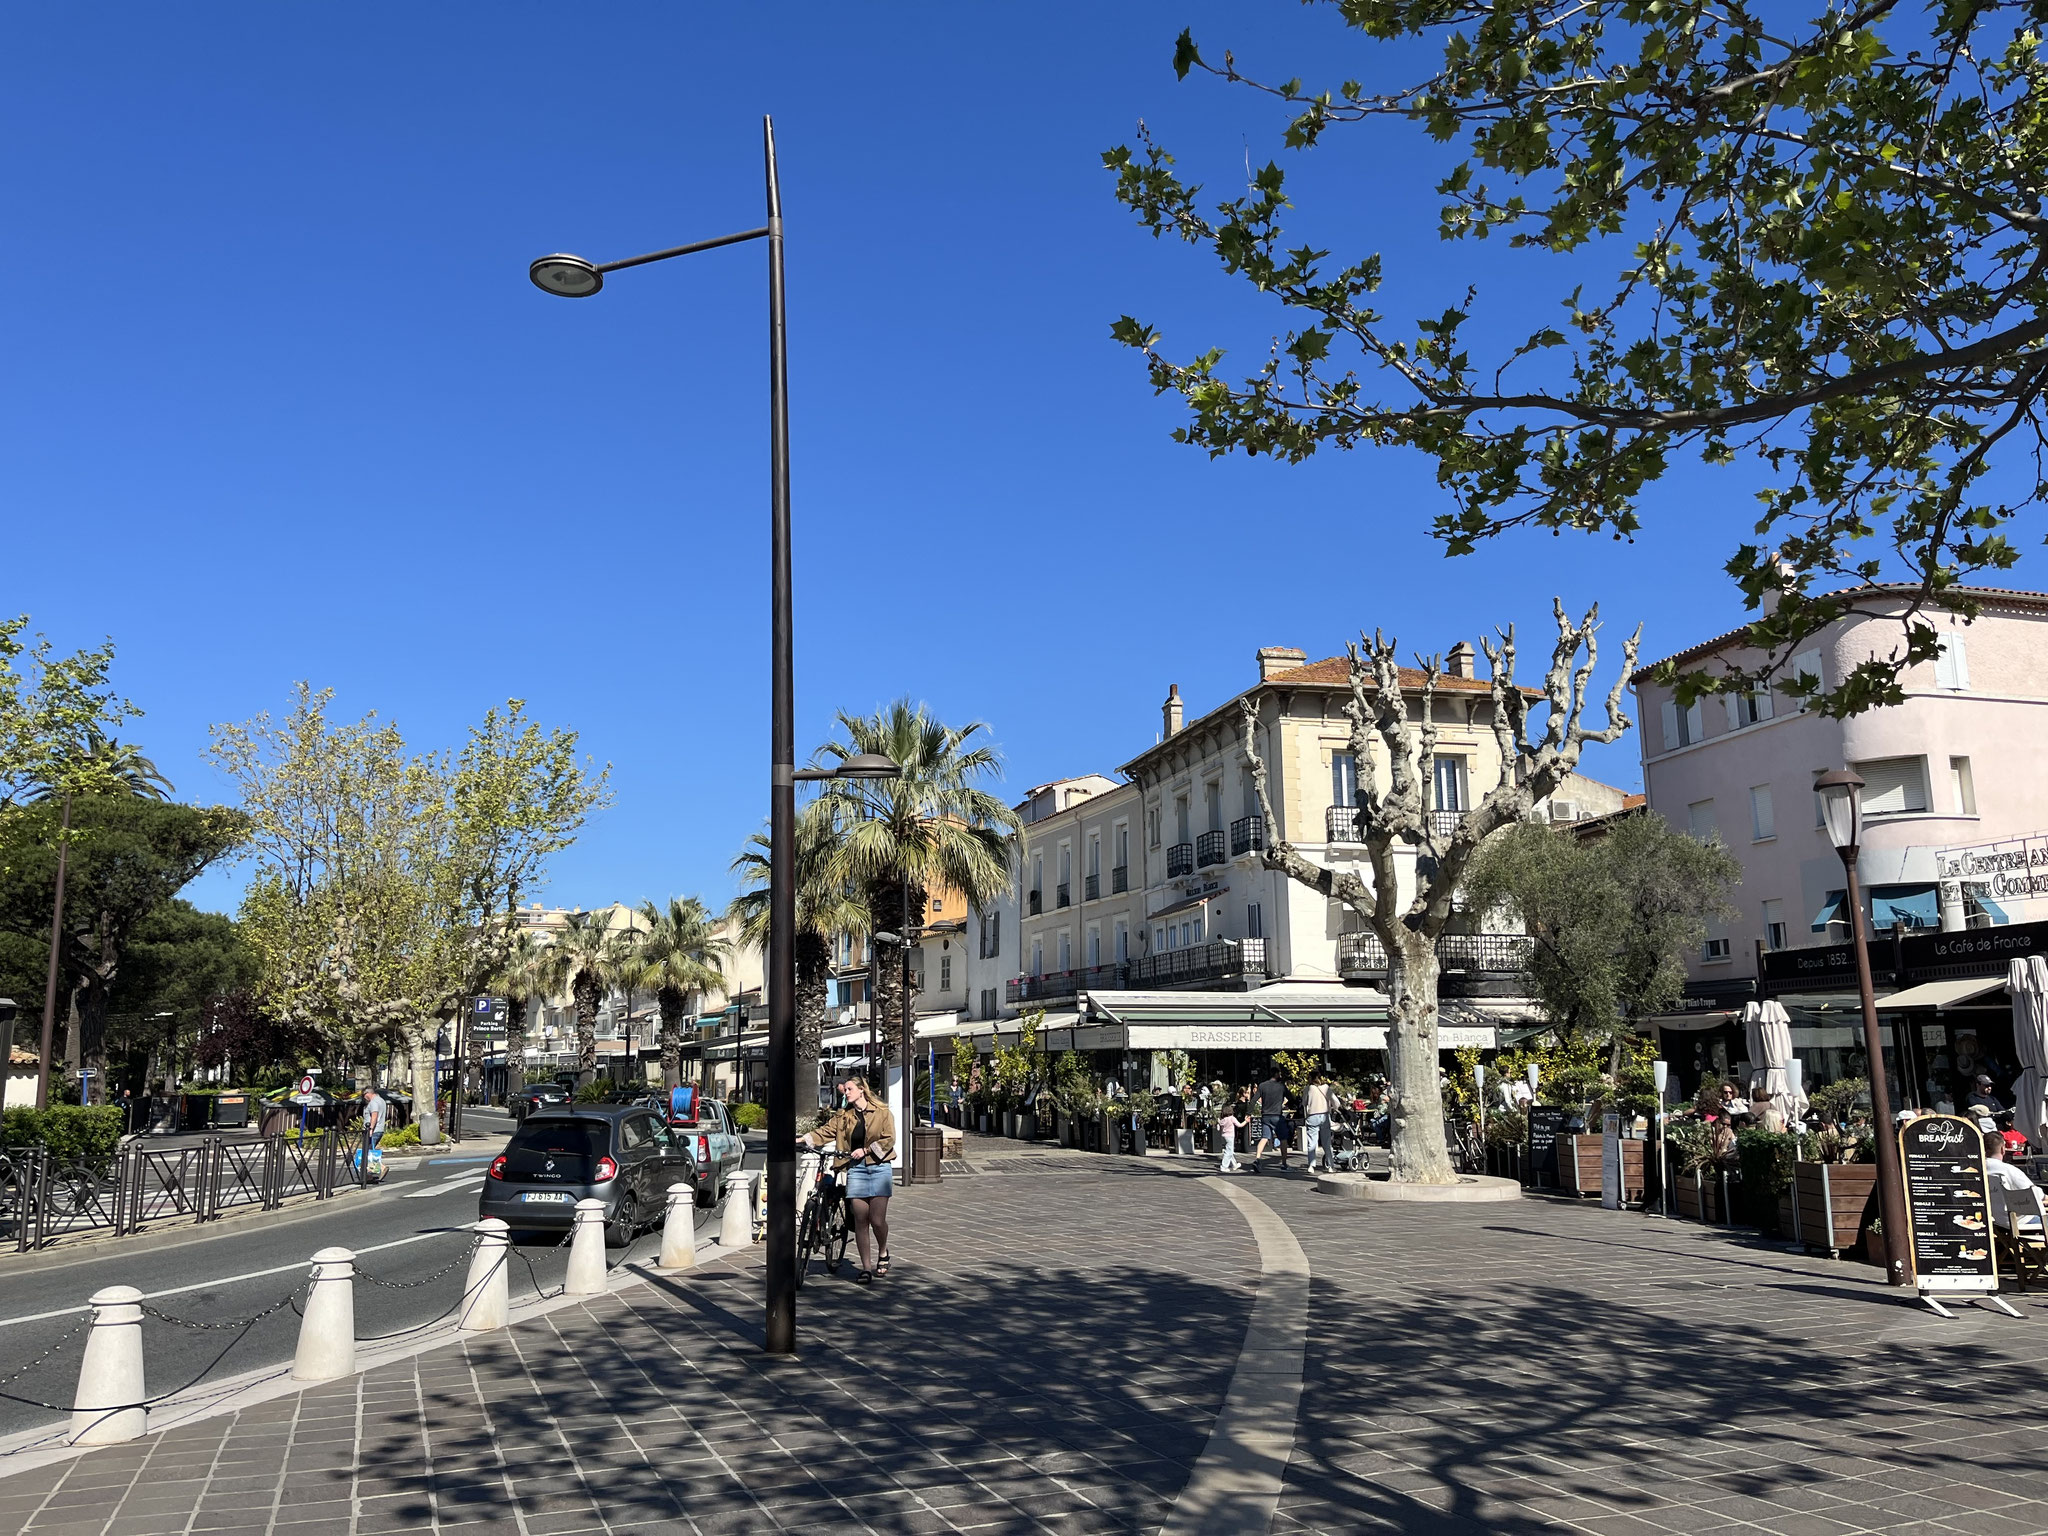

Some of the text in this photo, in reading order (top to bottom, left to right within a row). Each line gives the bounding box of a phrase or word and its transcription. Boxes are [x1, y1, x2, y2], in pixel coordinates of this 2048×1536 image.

[1934, 935, 2031, 955] Le Café de France
[1797, 958, 1824, 971] Depuis
[478, 1000, 487, 1011] P
[1190, 1031, 1262, 1042] BRASSERIE
[1453, 1032, 1488, 1042] Bianca
